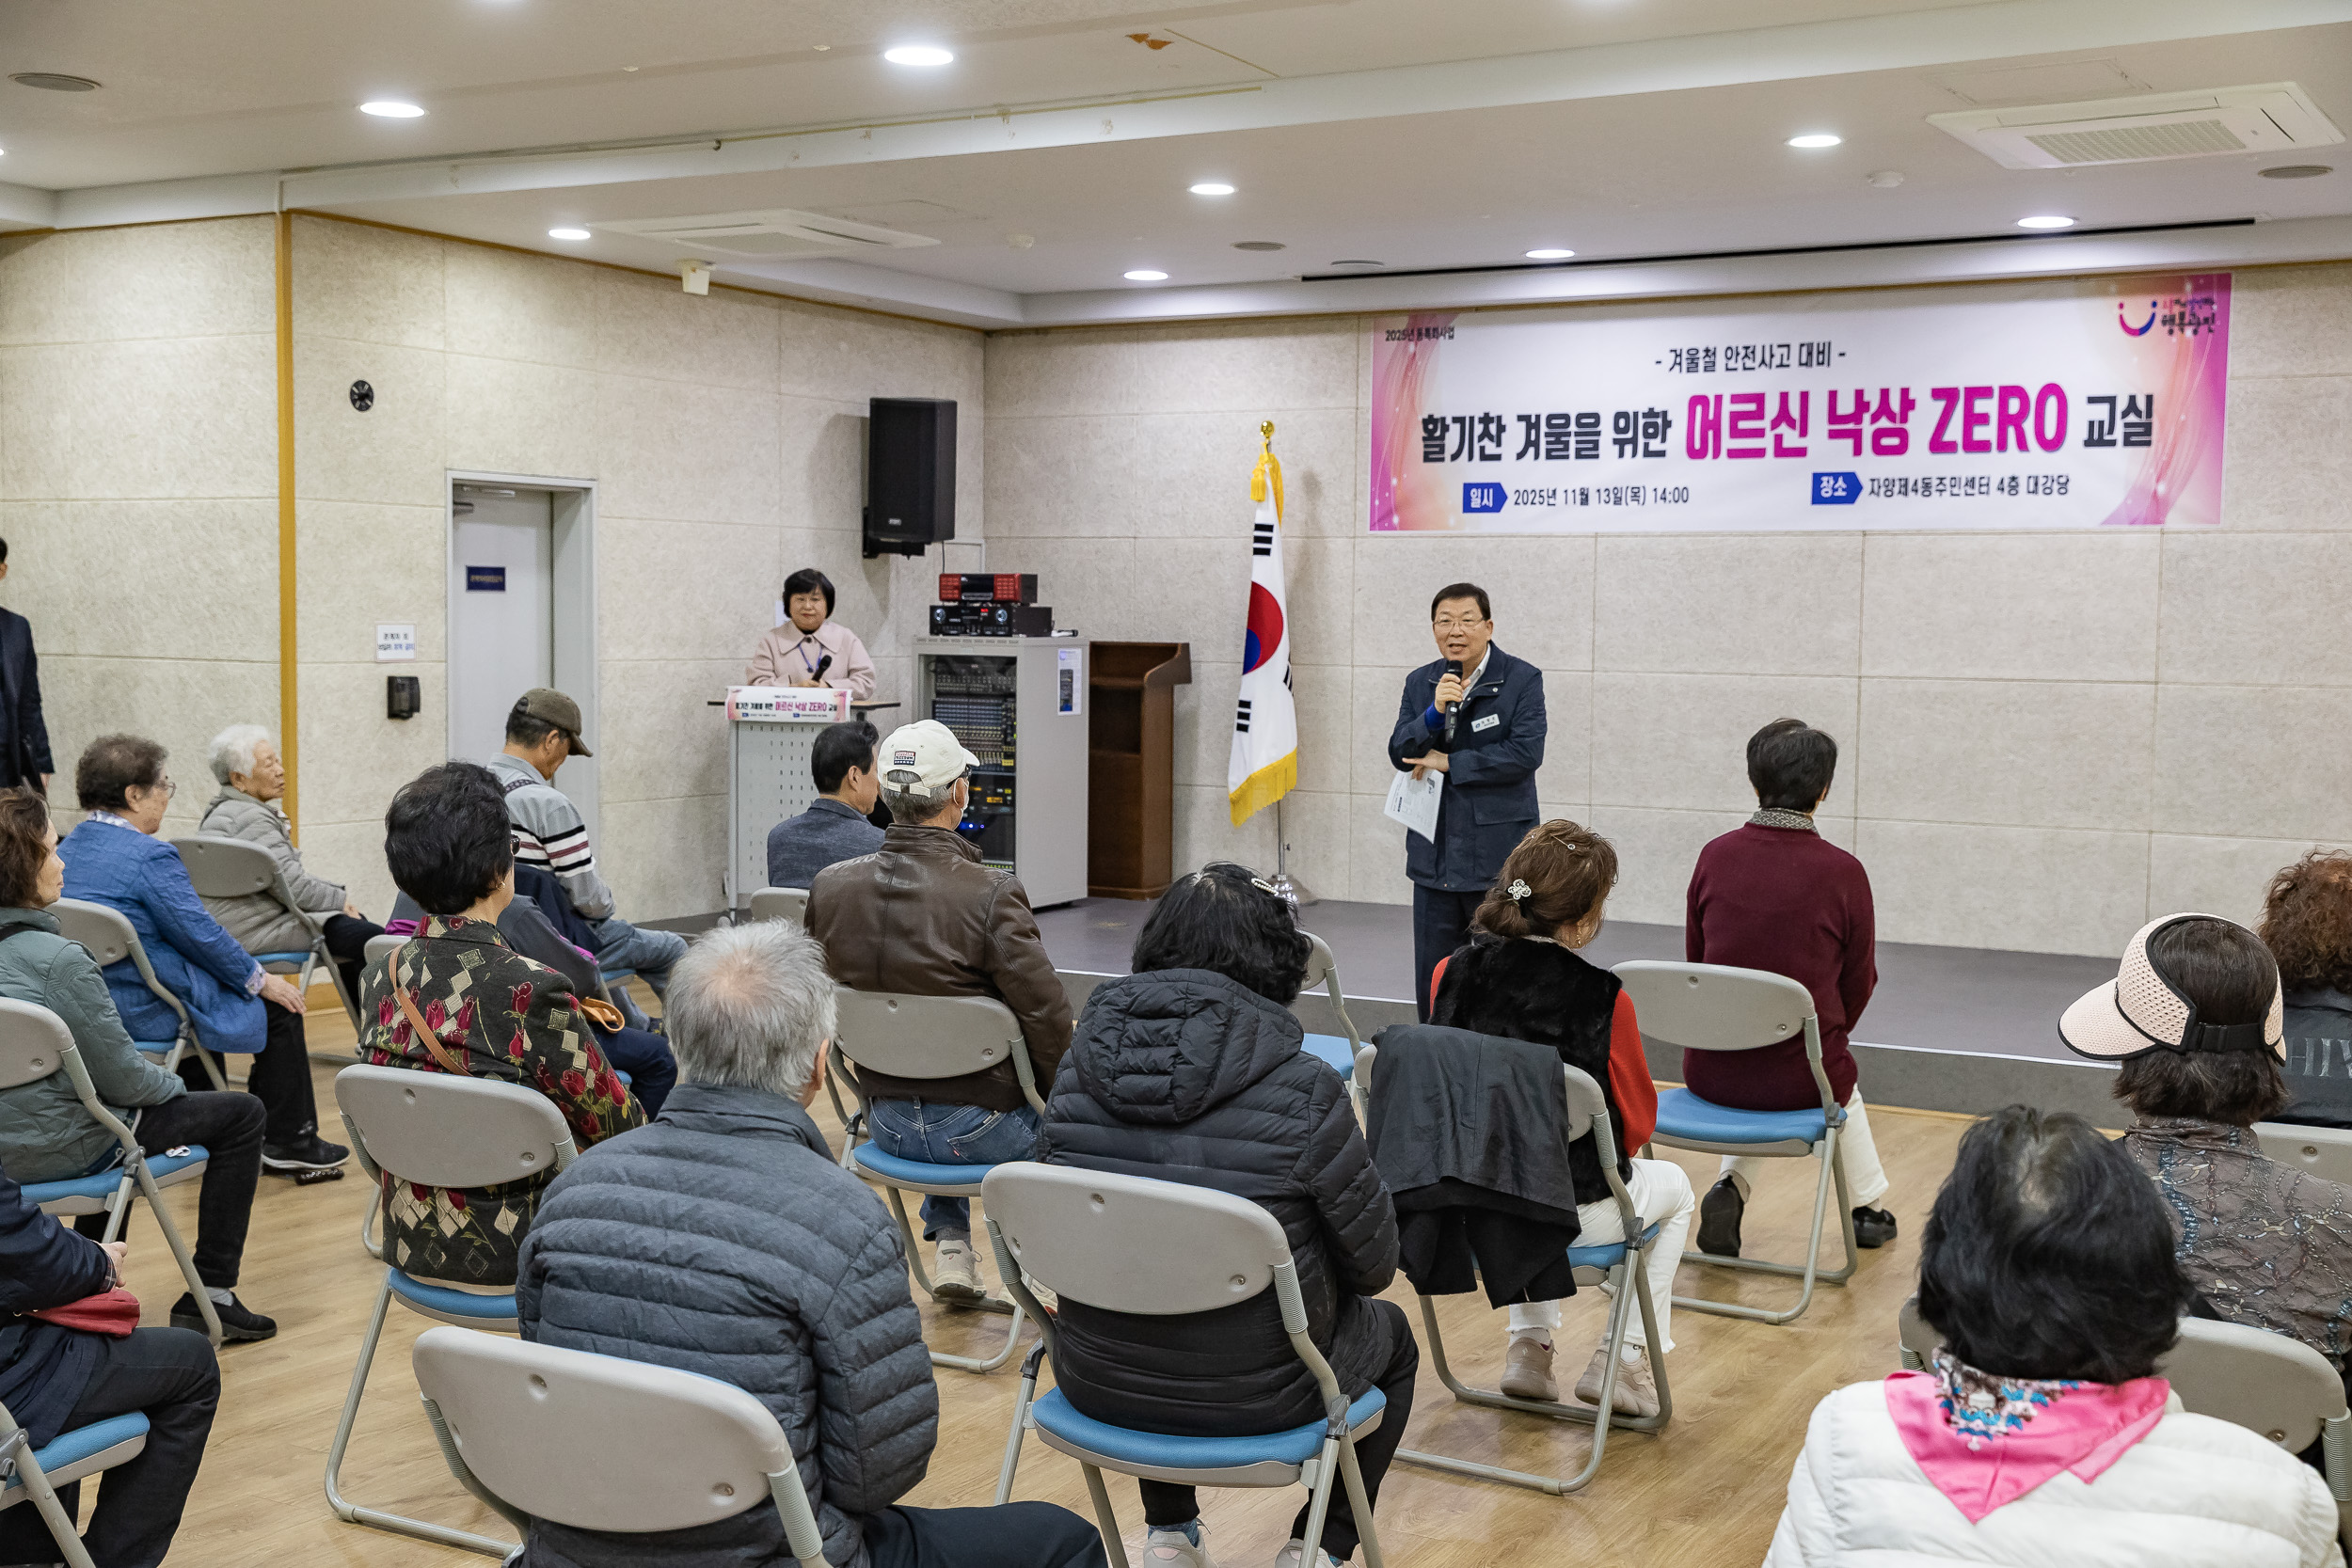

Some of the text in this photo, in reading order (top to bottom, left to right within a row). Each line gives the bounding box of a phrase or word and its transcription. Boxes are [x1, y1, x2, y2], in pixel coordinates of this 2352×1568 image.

[1669, 346, 1717, 373] 겨울철
[1724, 342, 1791, 372] 안전사고
[1798, 341, 1832, 368] 대비
[1422, 381, 2155, 464] 활기찬 겨울을 위한 어르신 낙상 ZERO 교실
[1470, 484, 1690, 509] 일시 2025년 11월 13일(목) 14:00
[1820, 473, 2071, 499] 장소 자양제4동주민센터 4층 대강당
[809, 702, 827, 712] ZERO
